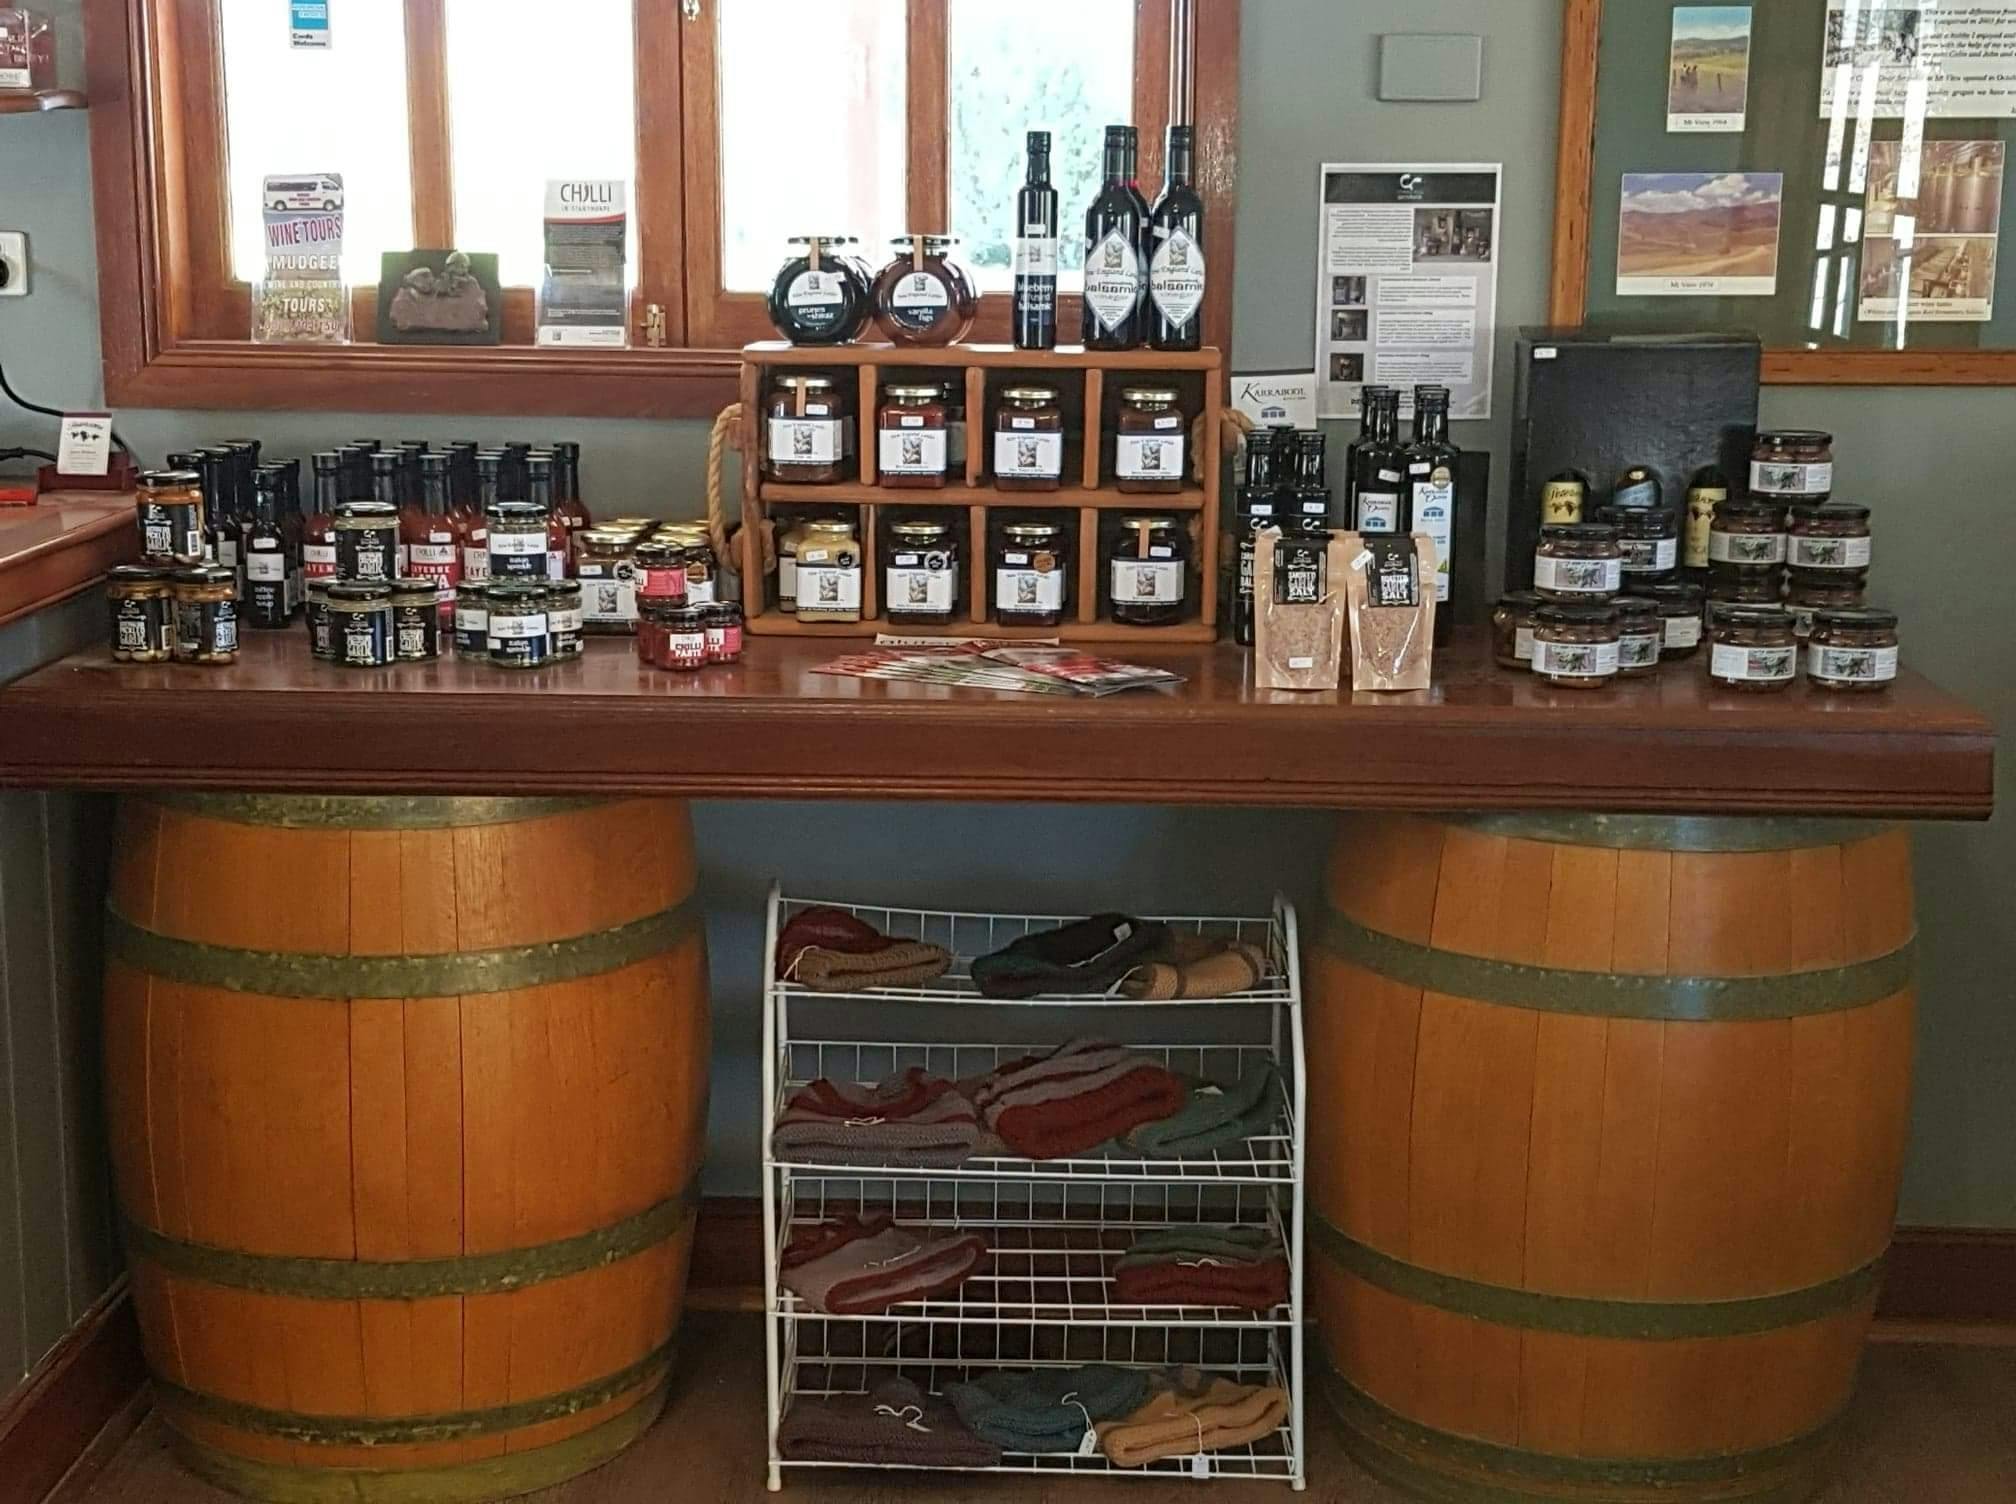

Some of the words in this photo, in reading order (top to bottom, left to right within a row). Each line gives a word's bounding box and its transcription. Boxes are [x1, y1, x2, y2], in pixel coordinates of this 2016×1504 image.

[267, 221, 301, 248] WINE
[303, 216, 343, 243] TOURS
[272, 255, 338, 271] MUDGEE
[283, 297, 328, 313] TOURS
[1382, 591, 1408, 600] SALT
